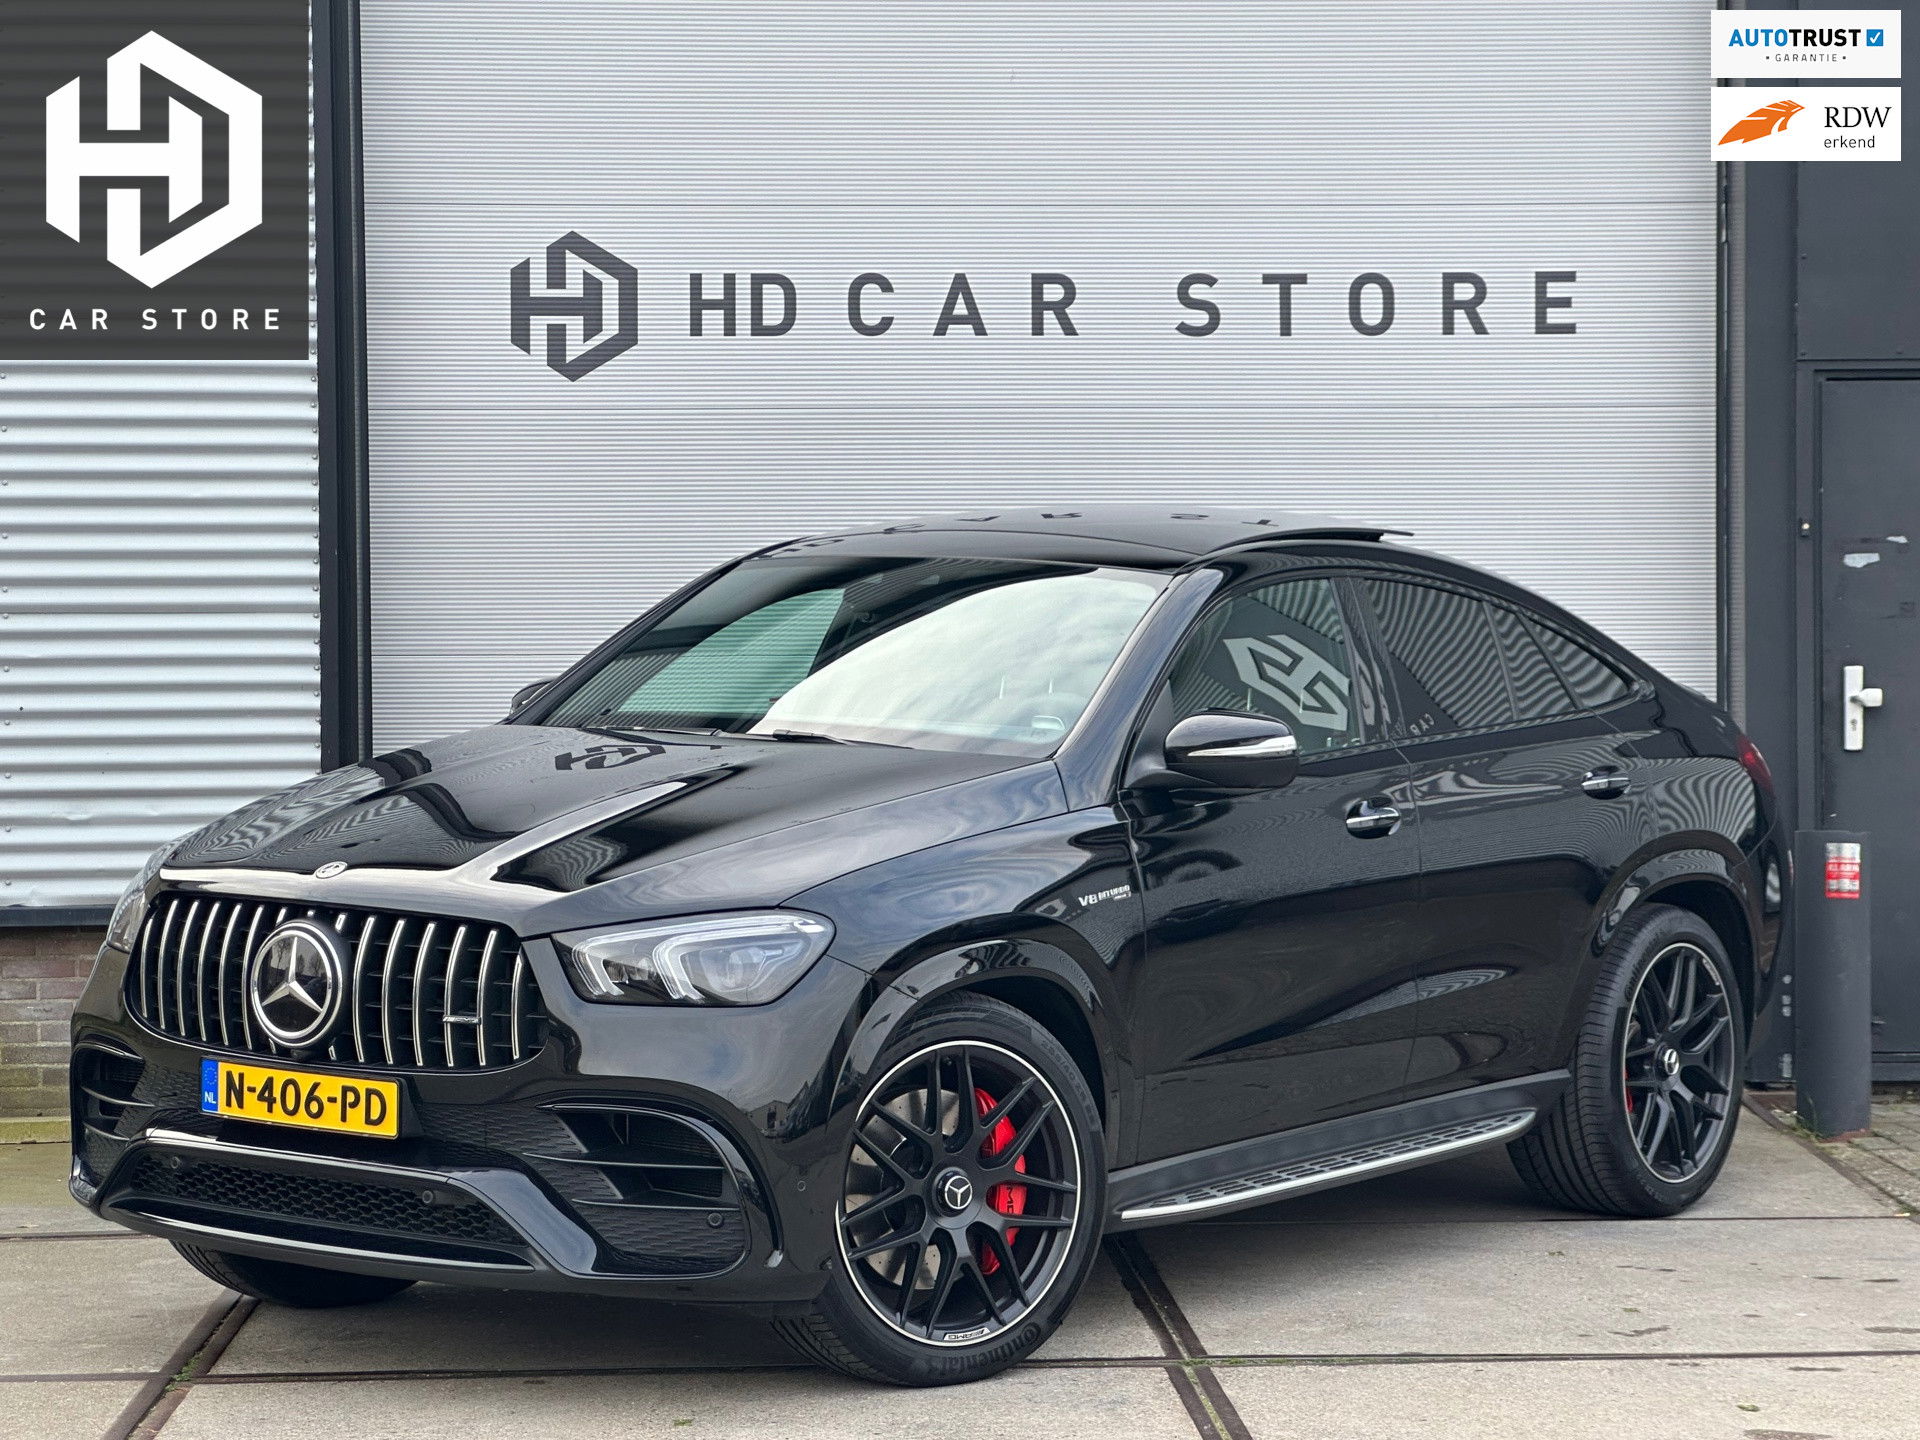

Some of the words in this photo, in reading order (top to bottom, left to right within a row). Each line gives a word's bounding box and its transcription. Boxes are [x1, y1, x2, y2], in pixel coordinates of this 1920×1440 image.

[689, 273, 797, 337] HD
[847, 272, 1079, 337] CAR
[1175, 271, 1577, 337] STORE
[204, 1091, 216, 1104] NL
[225, 1070, 387, 1126] N-406-PD
